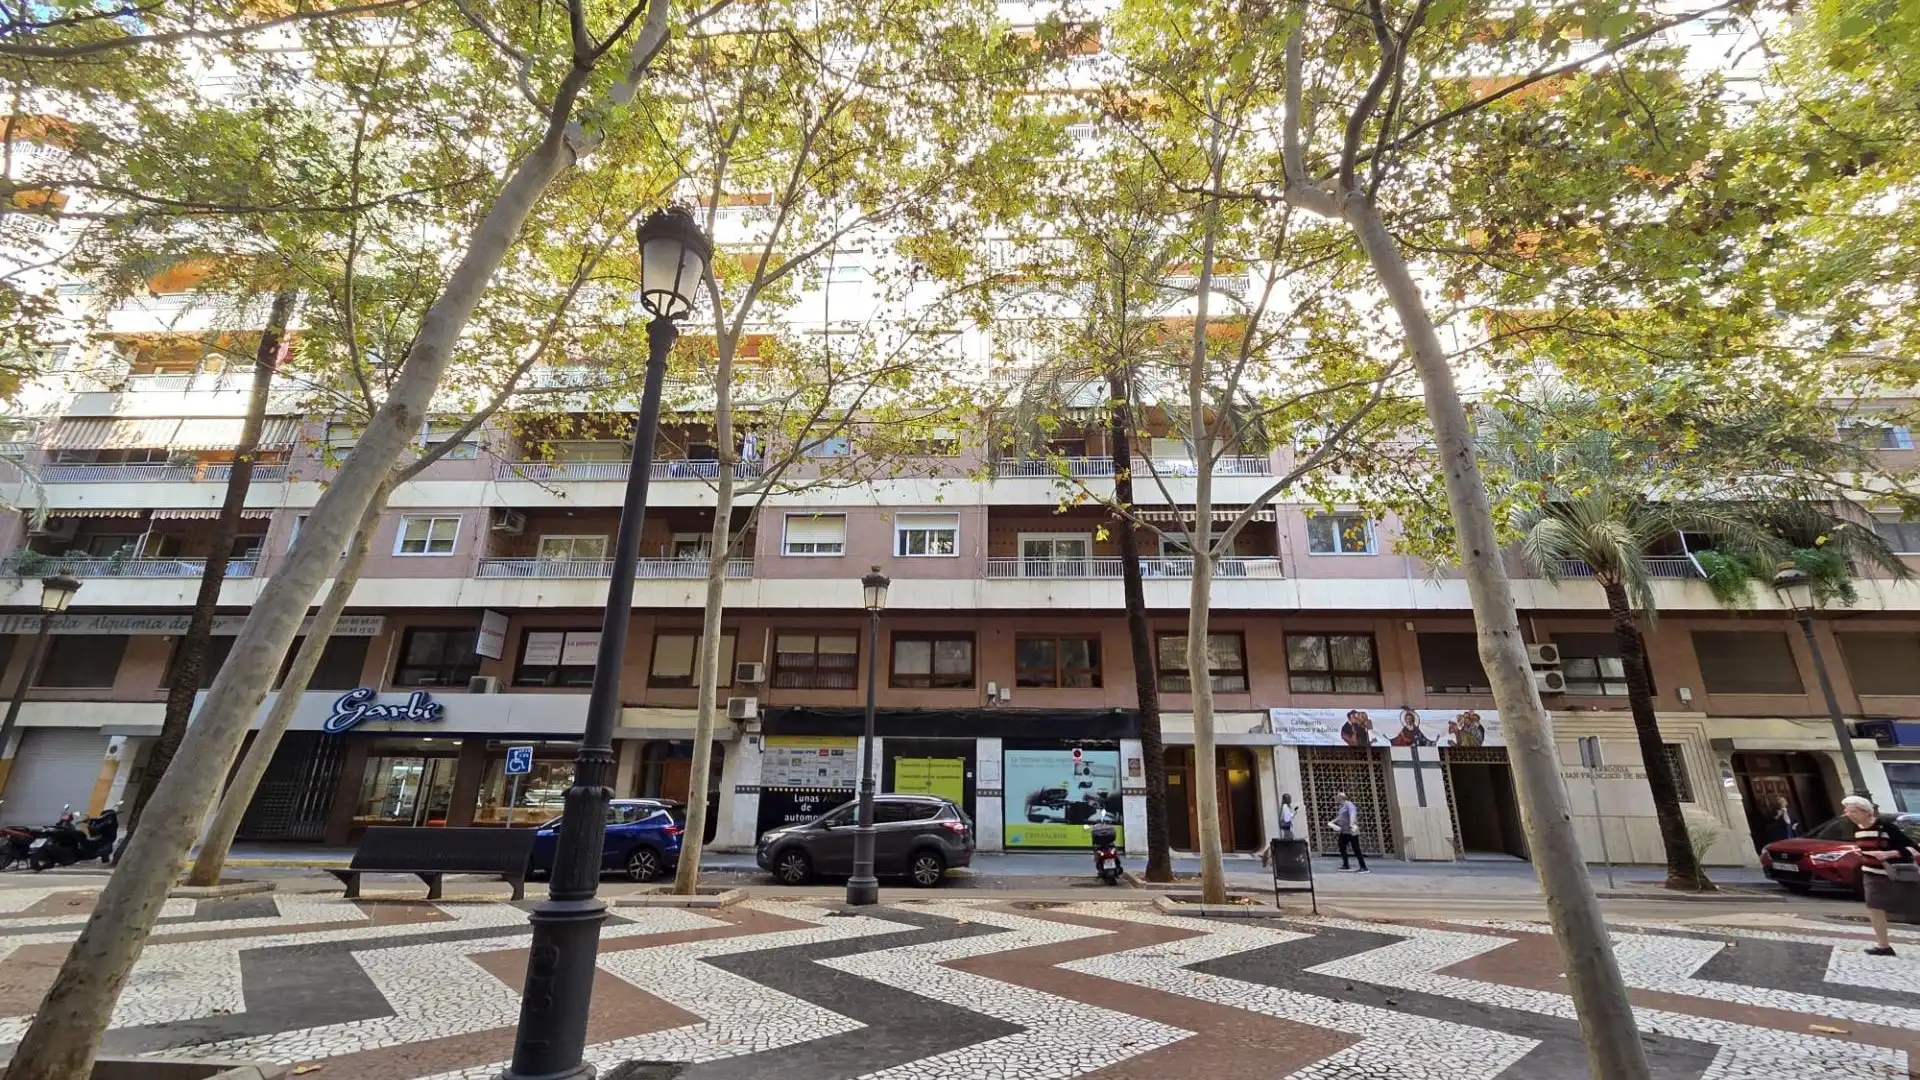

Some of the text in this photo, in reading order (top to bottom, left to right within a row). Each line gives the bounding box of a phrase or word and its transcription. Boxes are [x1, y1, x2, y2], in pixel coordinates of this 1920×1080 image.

[21, 615, 82, 631] Esuela
[169, 615, 189, 631] de
[794, 793, 820, 803] Lunas
[800, 803, 812, 812] de
